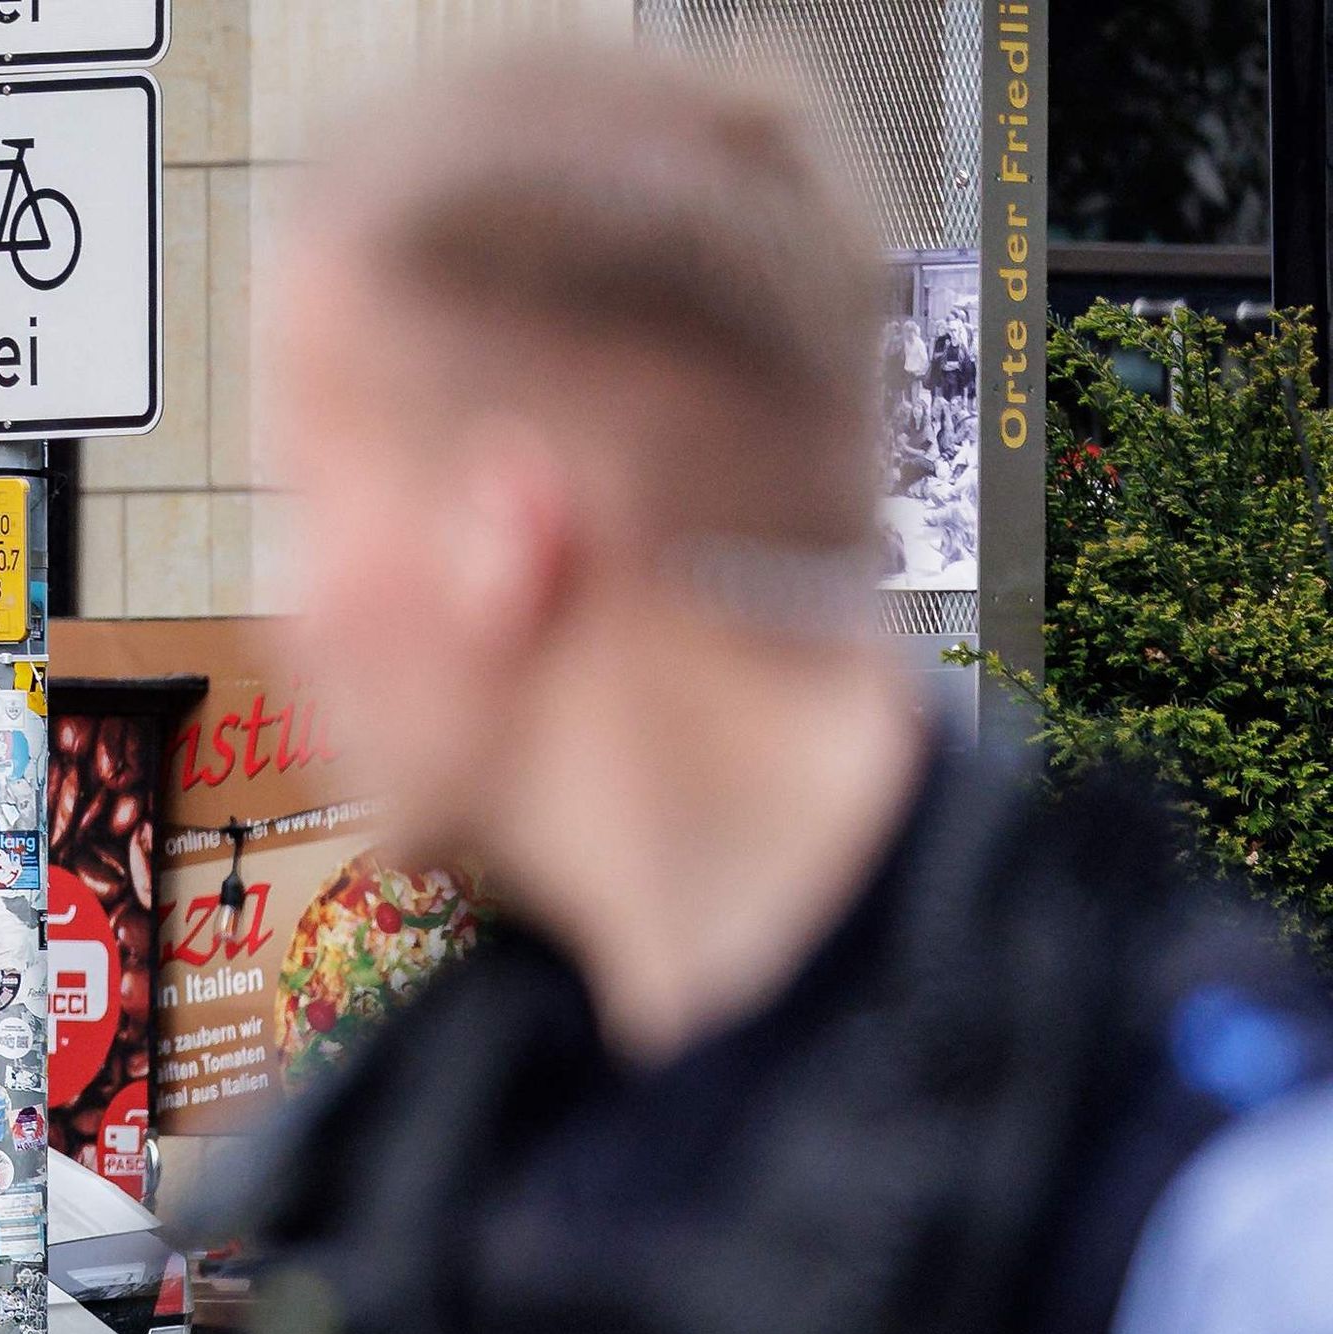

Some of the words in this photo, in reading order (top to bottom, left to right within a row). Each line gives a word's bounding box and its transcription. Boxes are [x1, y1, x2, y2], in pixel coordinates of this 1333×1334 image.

[999, 203, 1028, 302] der
[1001, 319, 1028, 450] Orte
[165, 829, 221, 856] online
[186, 966, 264, 1005] Italien
[174, 1023, 237, 1054] zaubern
[239, 1015, 263, 1039] wir
[201, 1044, 266, 1075] Tomaten
[192, 1083, 219, 1105] aus
[221, 1071, 269, 1098] Italien
